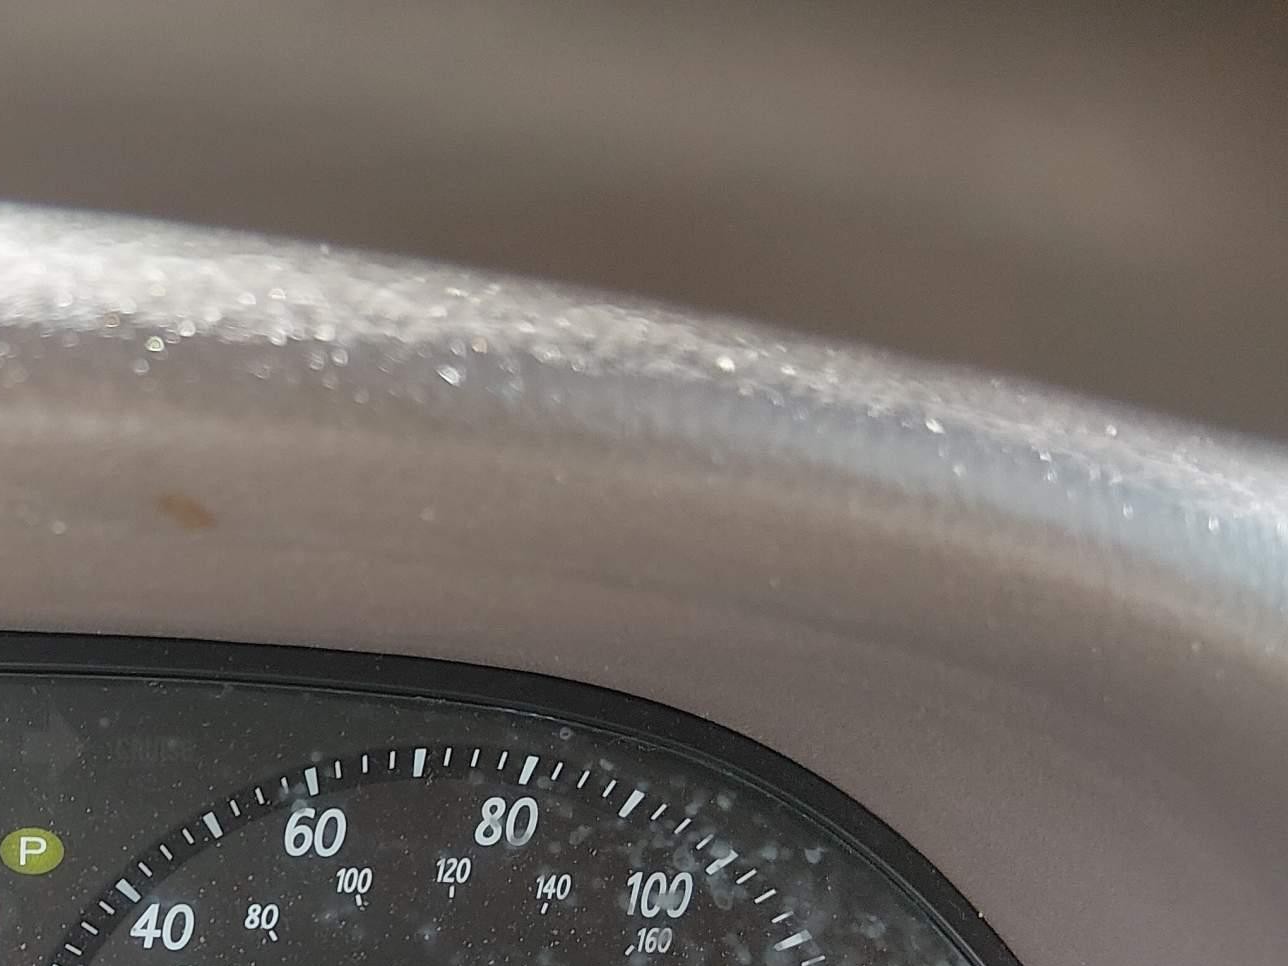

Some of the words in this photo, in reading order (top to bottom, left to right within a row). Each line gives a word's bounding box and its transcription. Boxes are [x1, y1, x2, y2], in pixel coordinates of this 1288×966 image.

[284, 808, 347, 857] 60
[474, 797, 539, 847] 80
[19, 836, 48, 866] P
[335, 867, 373, 895] 100
[435, 857, 471, 884] 120
[535, 874, 572, 900] 140
[626, 871, 694, 919] 100
[130, 903, 196, 951] 40
[244, 904, 280, 930] 80
[636, 927, 673, 953] 160
